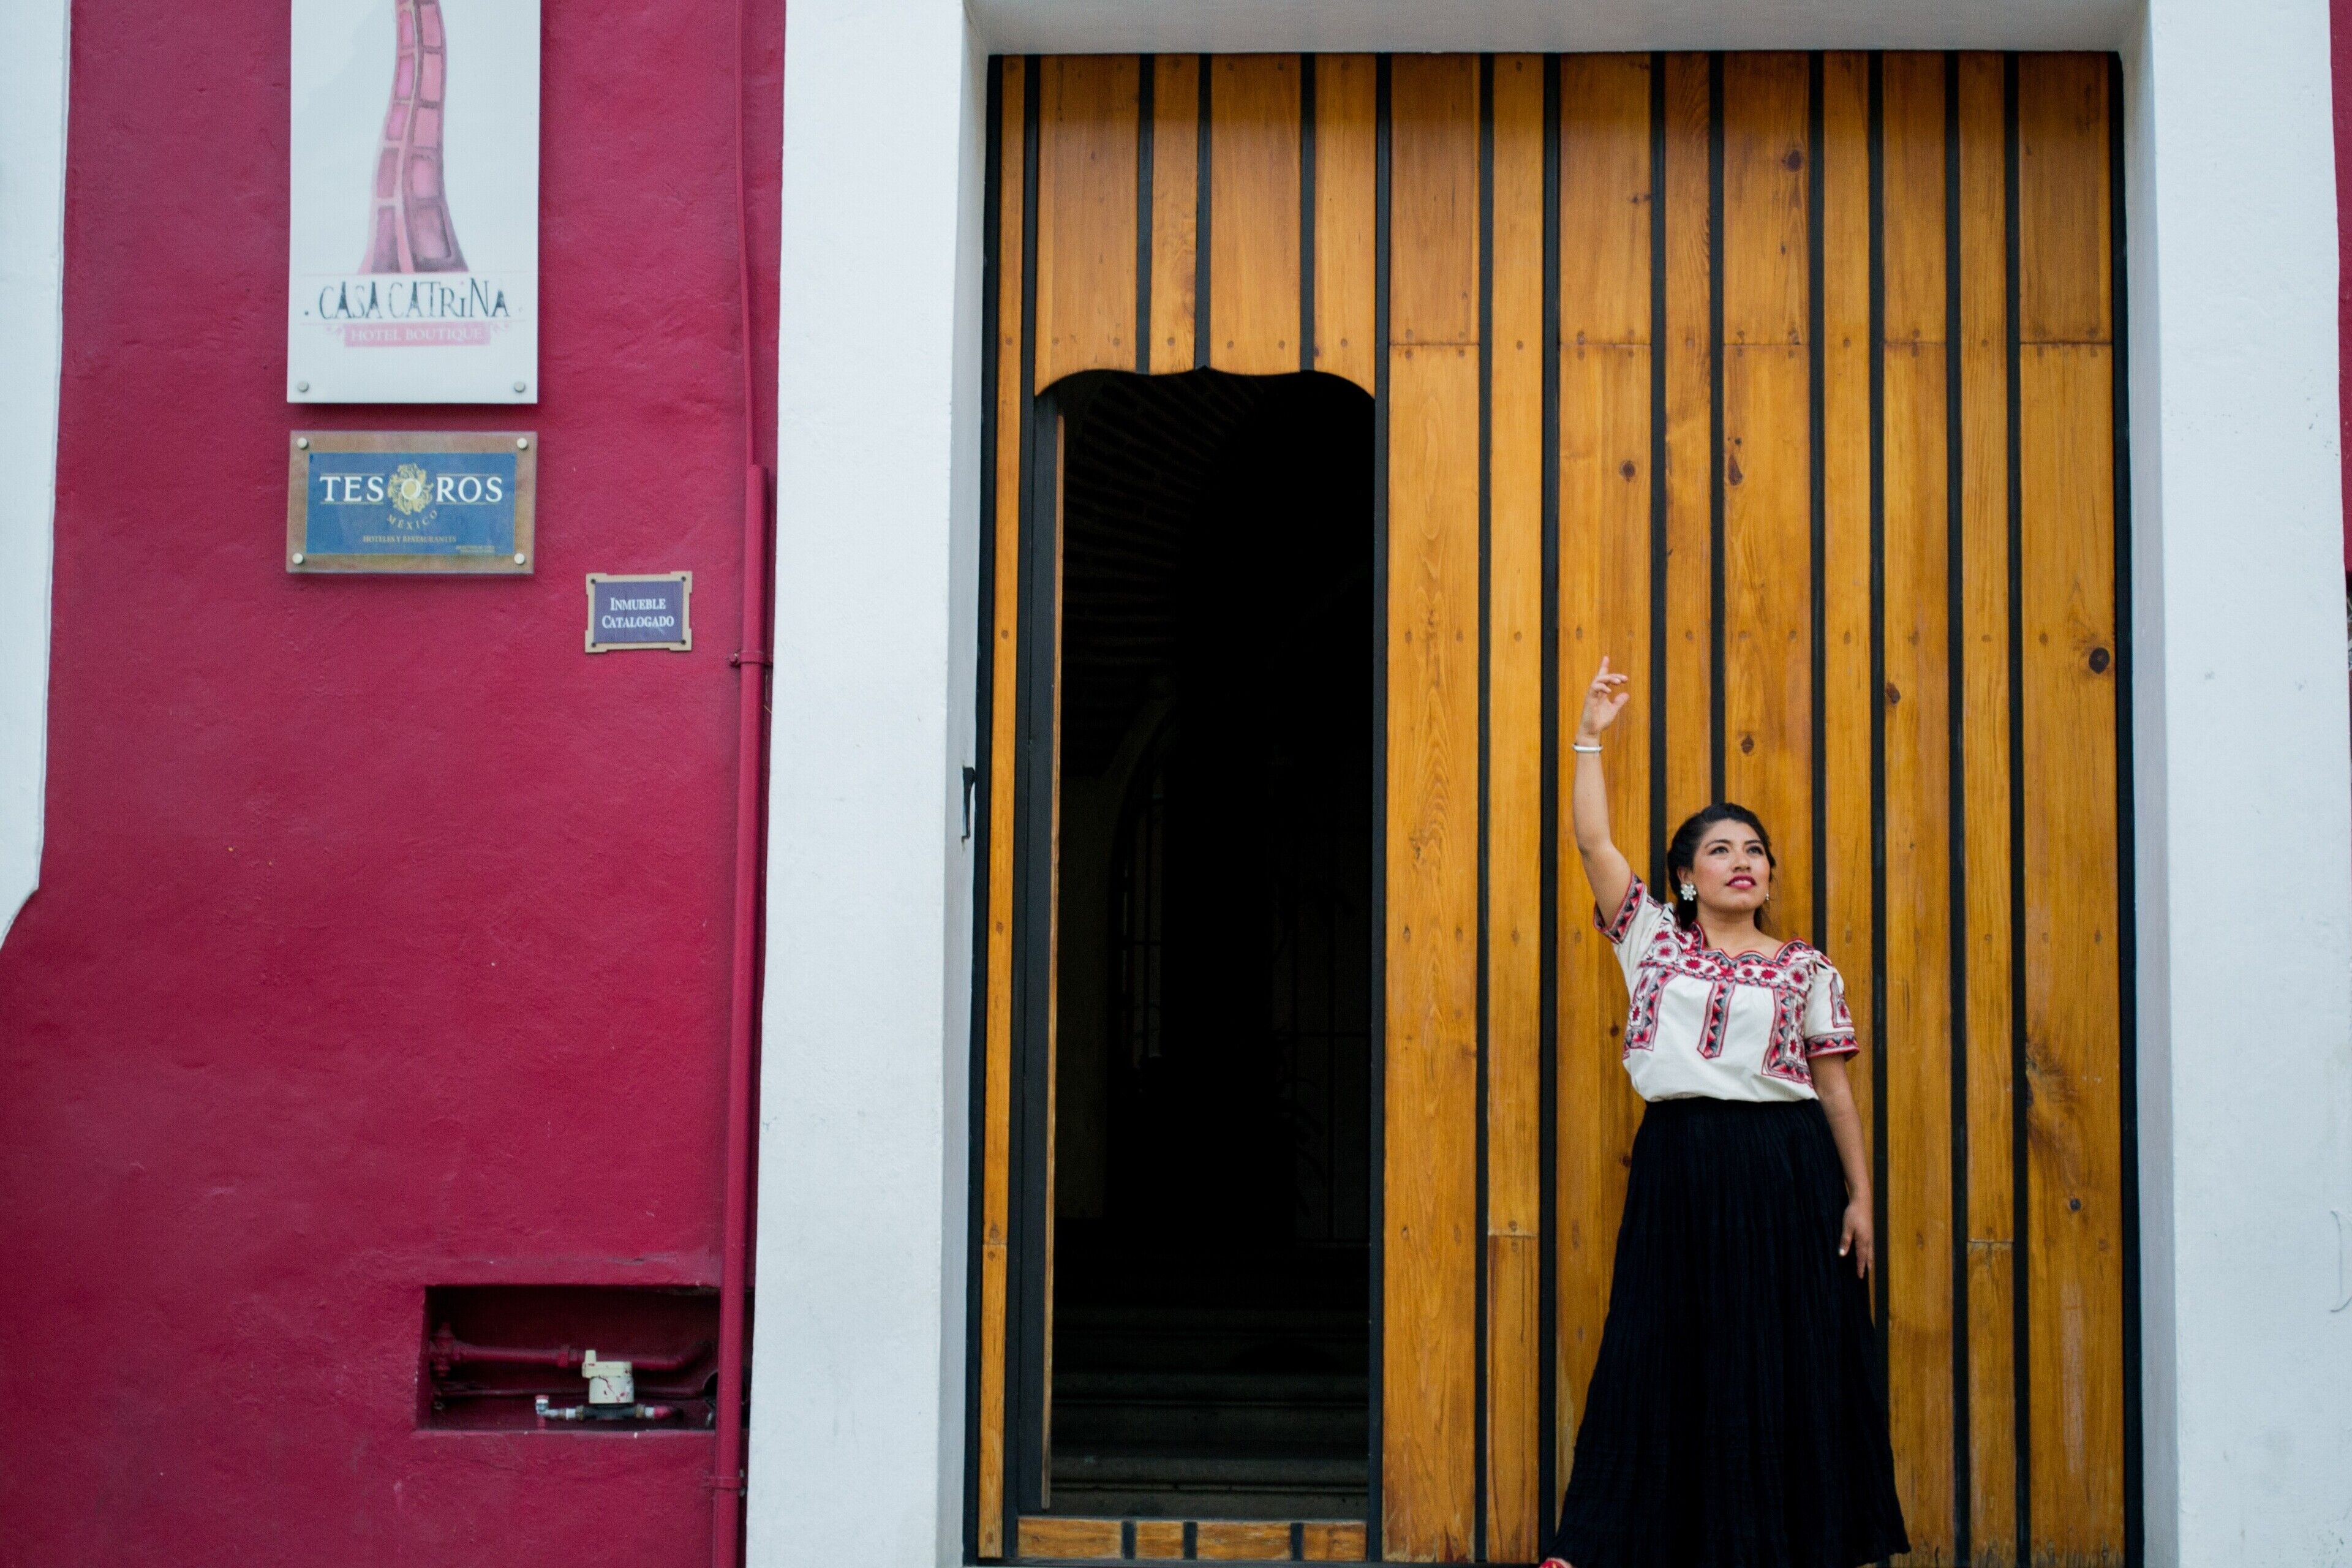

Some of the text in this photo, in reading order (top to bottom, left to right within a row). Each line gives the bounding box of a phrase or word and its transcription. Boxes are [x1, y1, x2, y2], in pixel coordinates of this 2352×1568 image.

[319, 281, 383, 320] CASA
[351, 327, 484, 343] HOTEL BOUTIQUE
[319, 475, 503, 503] TESOROS
[610, 597, 666, 611] INMUEBLE
[601, 615, 675, 629] CATALOGADO
